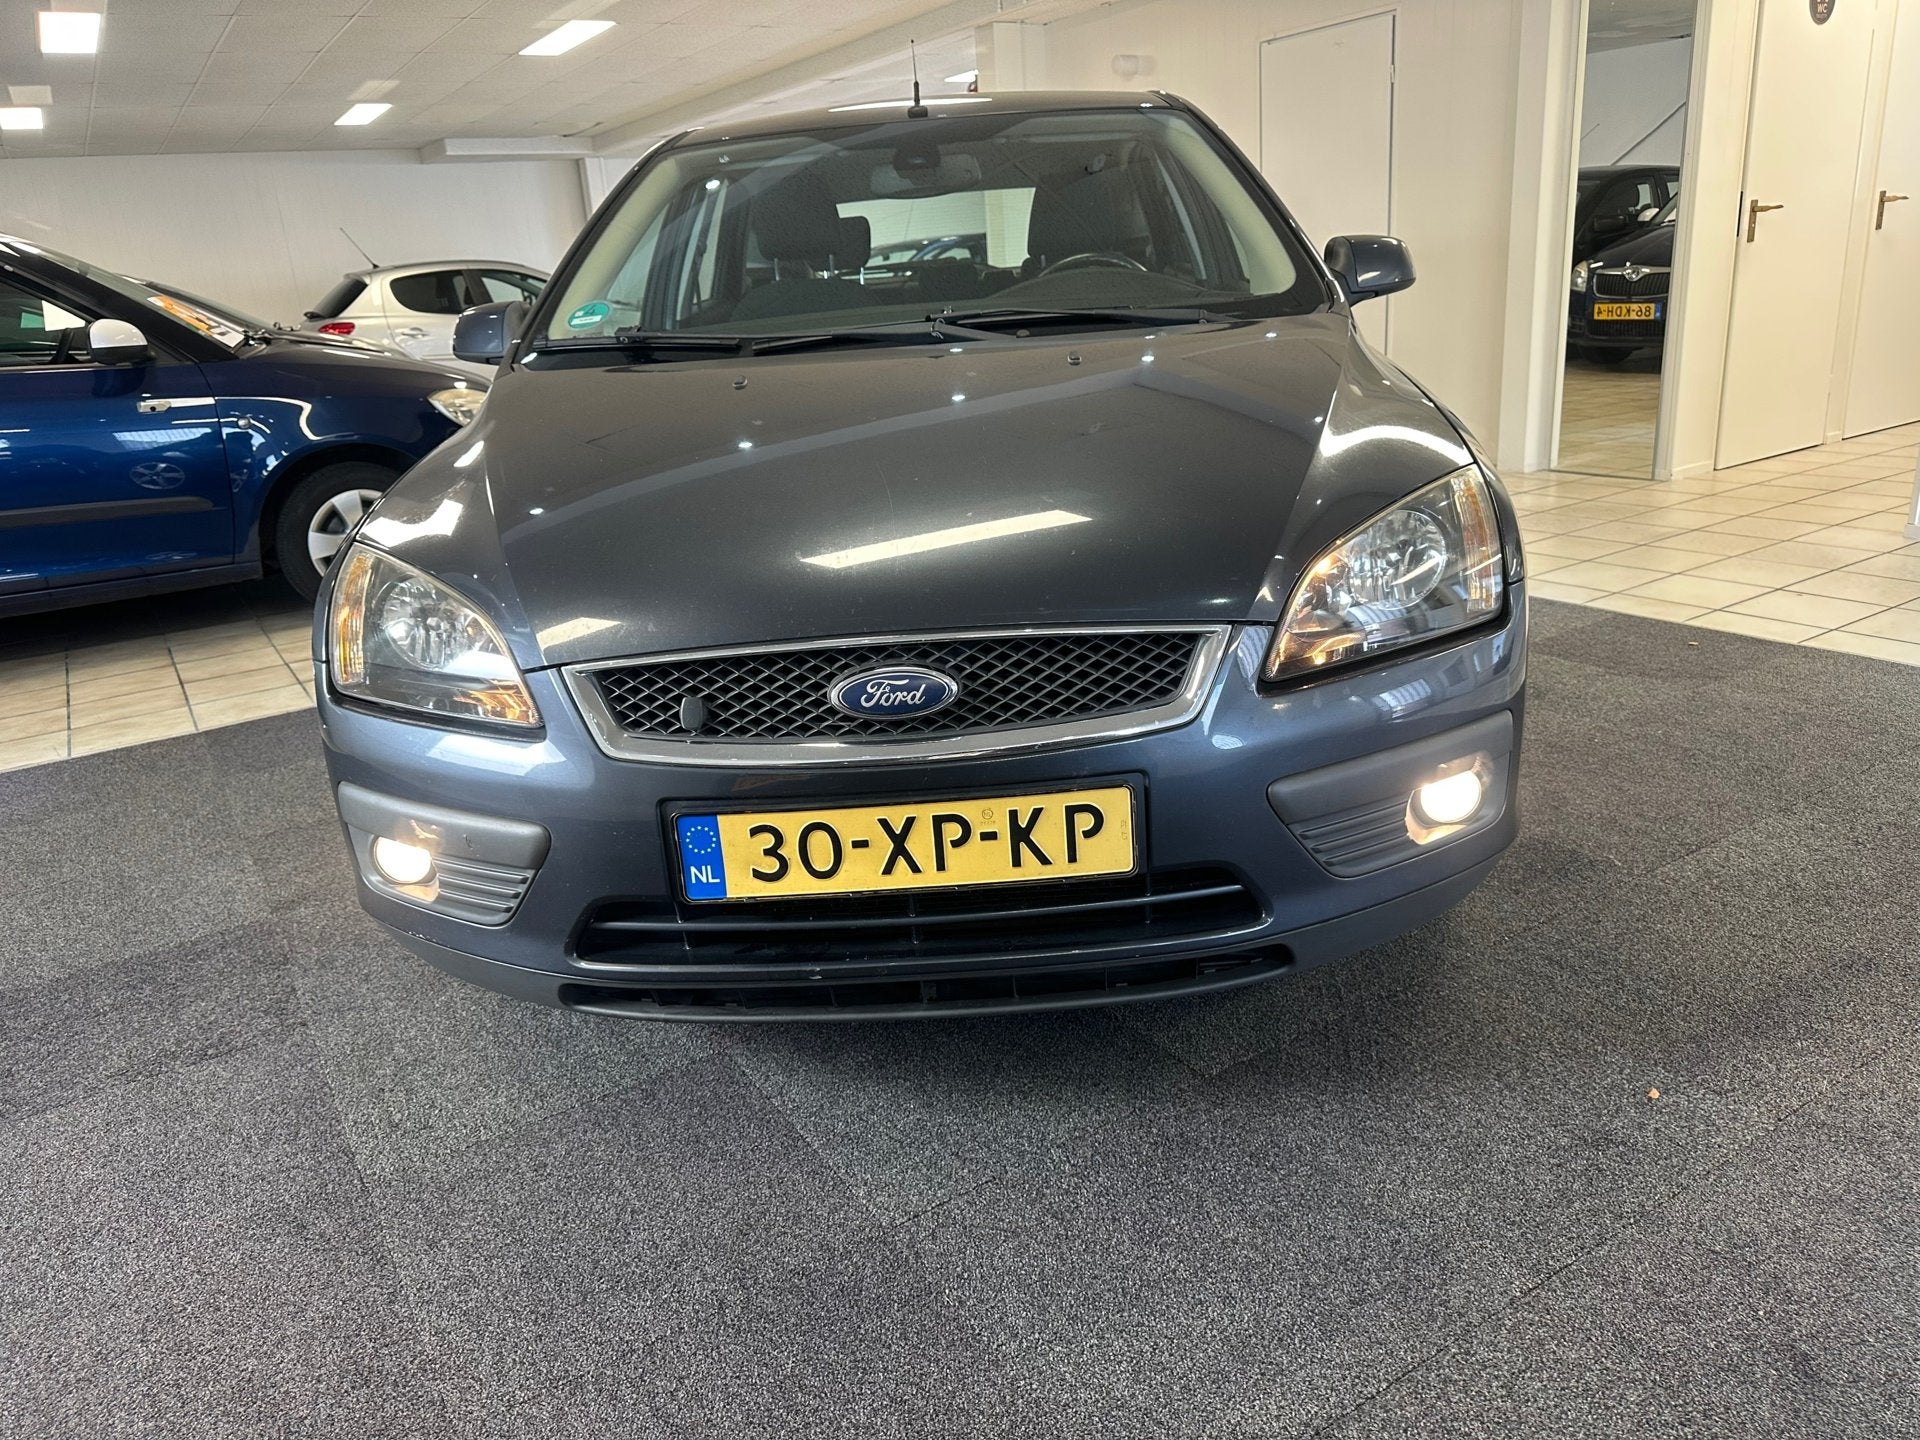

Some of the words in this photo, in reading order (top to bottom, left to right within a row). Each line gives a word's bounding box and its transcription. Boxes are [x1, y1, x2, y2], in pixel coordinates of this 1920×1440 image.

[1817, 3, 1828, 13] WC
[860, 678, 926, 708] Ford
[748, 803, 1104, 883] 30-XP-KP
[690, 865, 720, 884] NL
